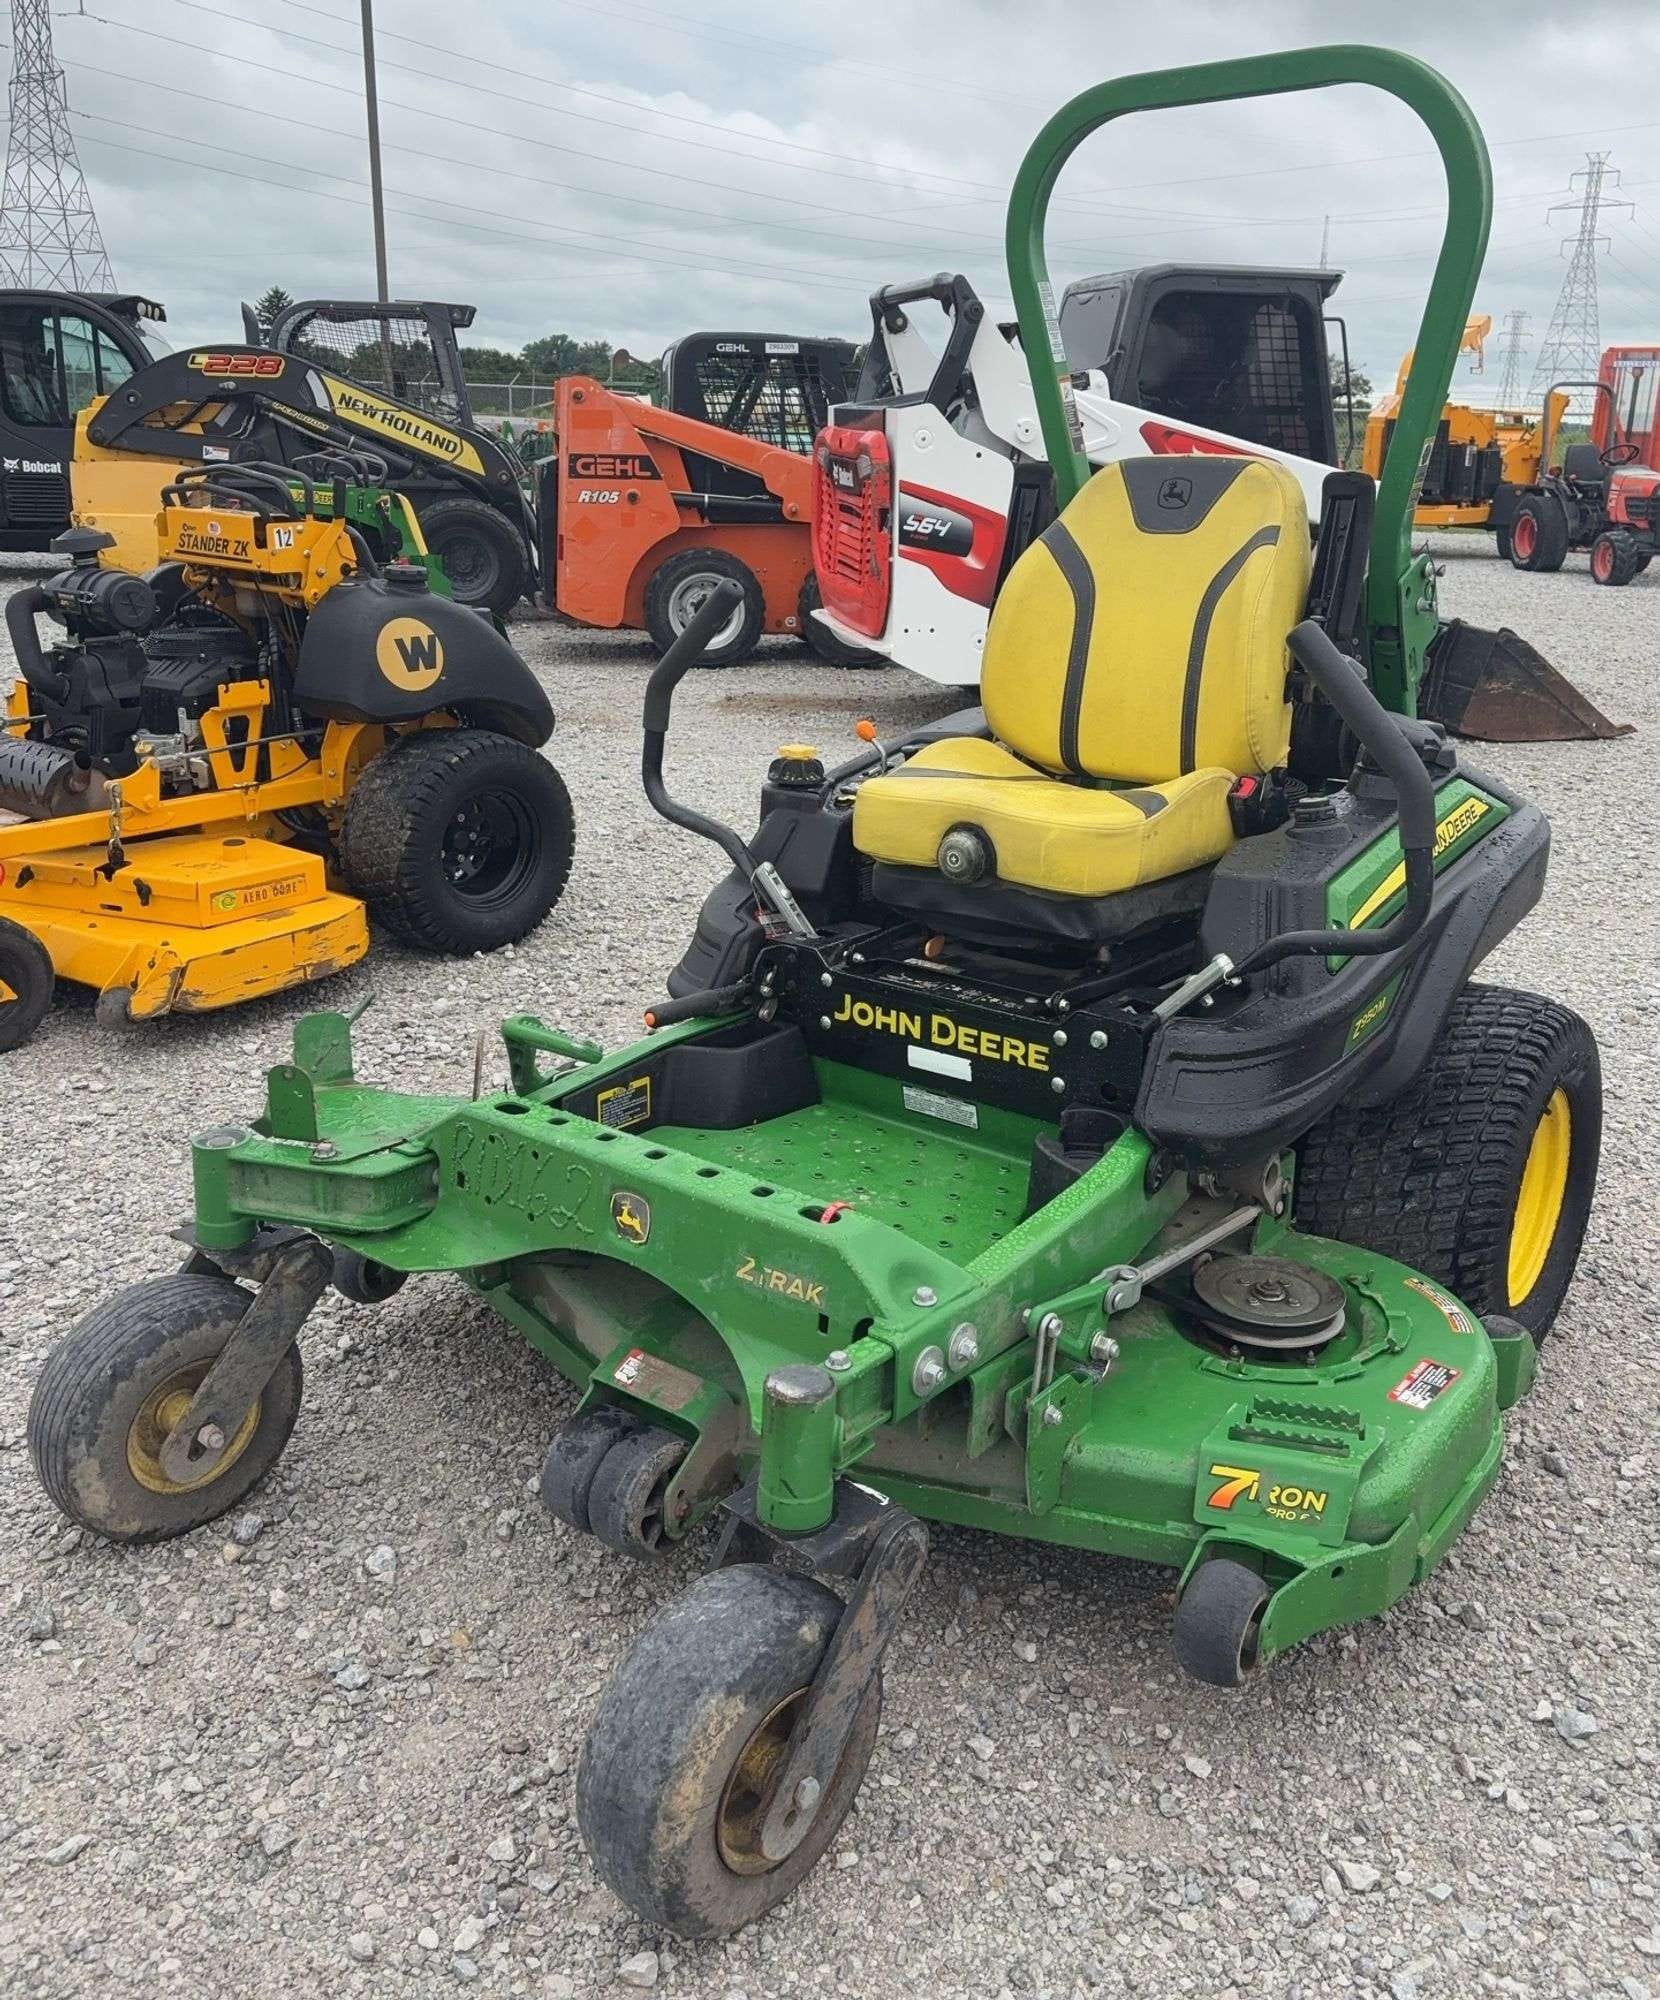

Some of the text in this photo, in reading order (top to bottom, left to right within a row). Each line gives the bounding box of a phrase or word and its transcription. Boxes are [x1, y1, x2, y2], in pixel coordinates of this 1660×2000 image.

[716, 343, 751, 353] GEHL
[189, 353, 285, 377] L228
[338, 392, 459, 454] NEW HOLLAND
[22, 460, 62, 474] Bobcat
[576, 457, 652, 476] GEHL
[578, 490, 621, 504] R105
[902, 514, 953, 537] S64
[178, 533, 250, 557] STANDER ZK
[393, 634, 437, 673] W
[1445, 804, 1478, 841] DEERE
[243, 888, 268, 905] AERO
[834, 993, 1050, 1072] JOHN DEERE
